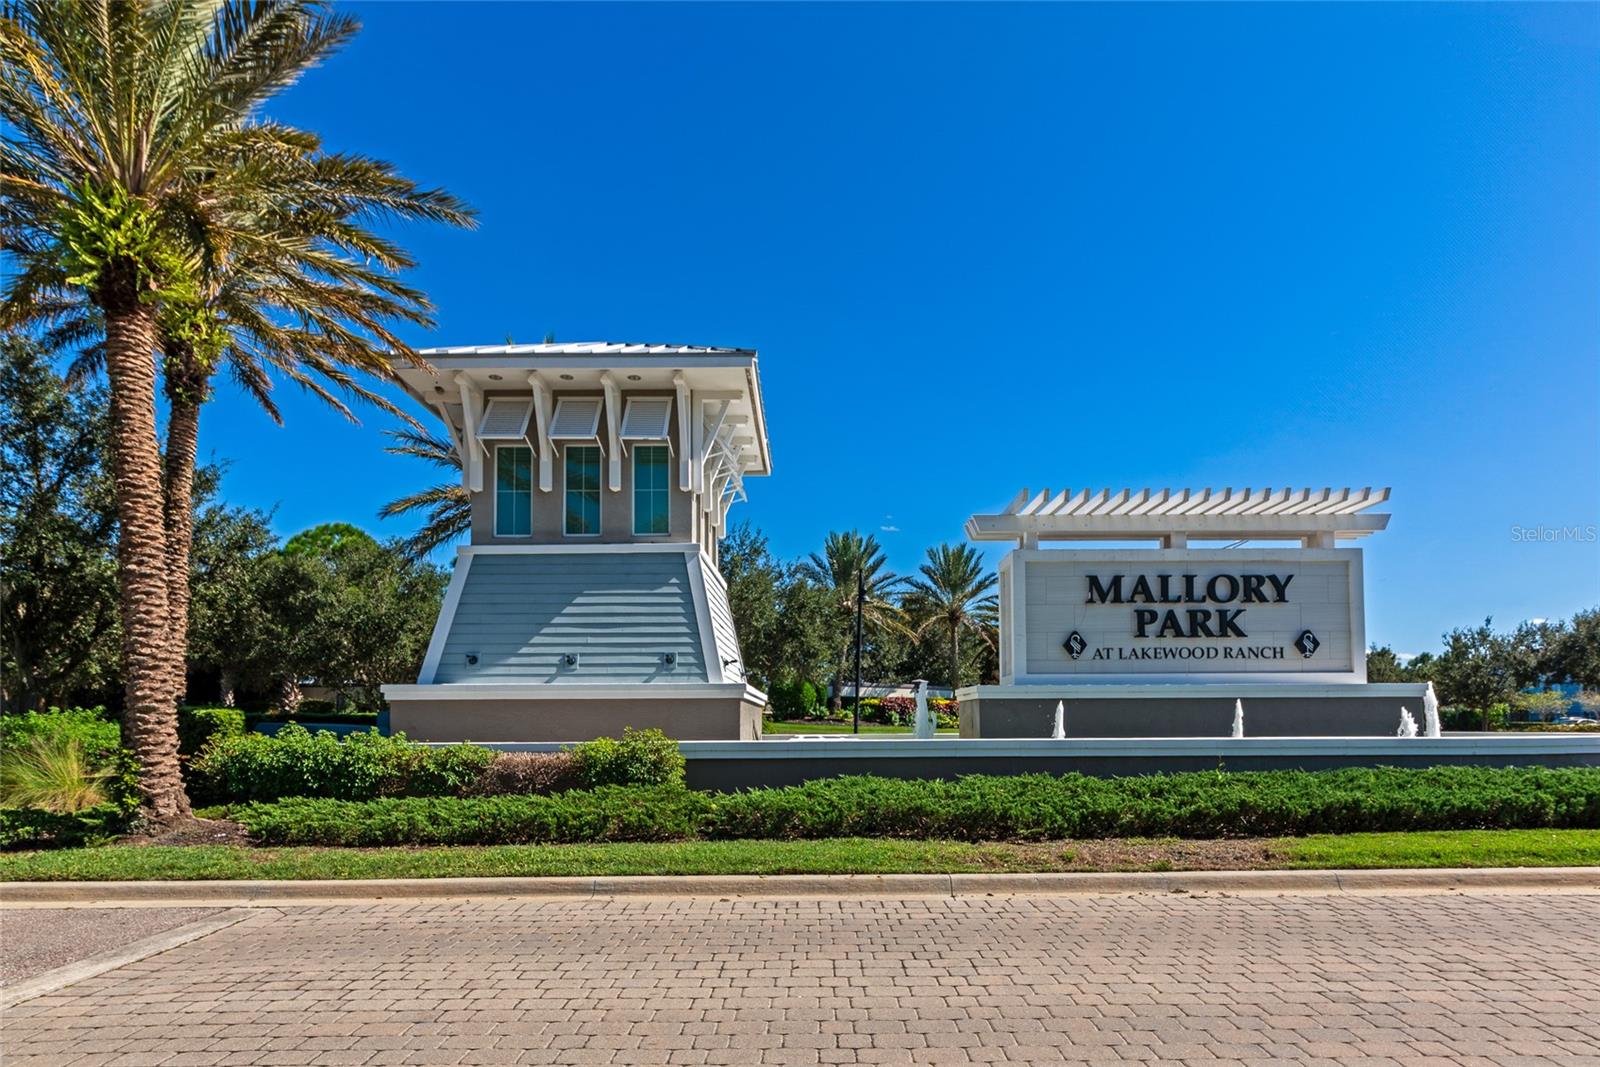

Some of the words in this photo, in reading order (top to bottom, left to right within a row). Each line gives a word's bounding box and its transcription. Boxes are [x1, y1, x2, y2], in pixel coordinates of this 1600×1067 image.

[1085, 573, 1295, 604] MALLORY
[1133, 608, 1249, 639] PARK
[1092, 647, 1114, 660] AT
[1118, 646, 1219, 660] LAKEWOOD
[1223, 646, 1285, 660] RANCH
